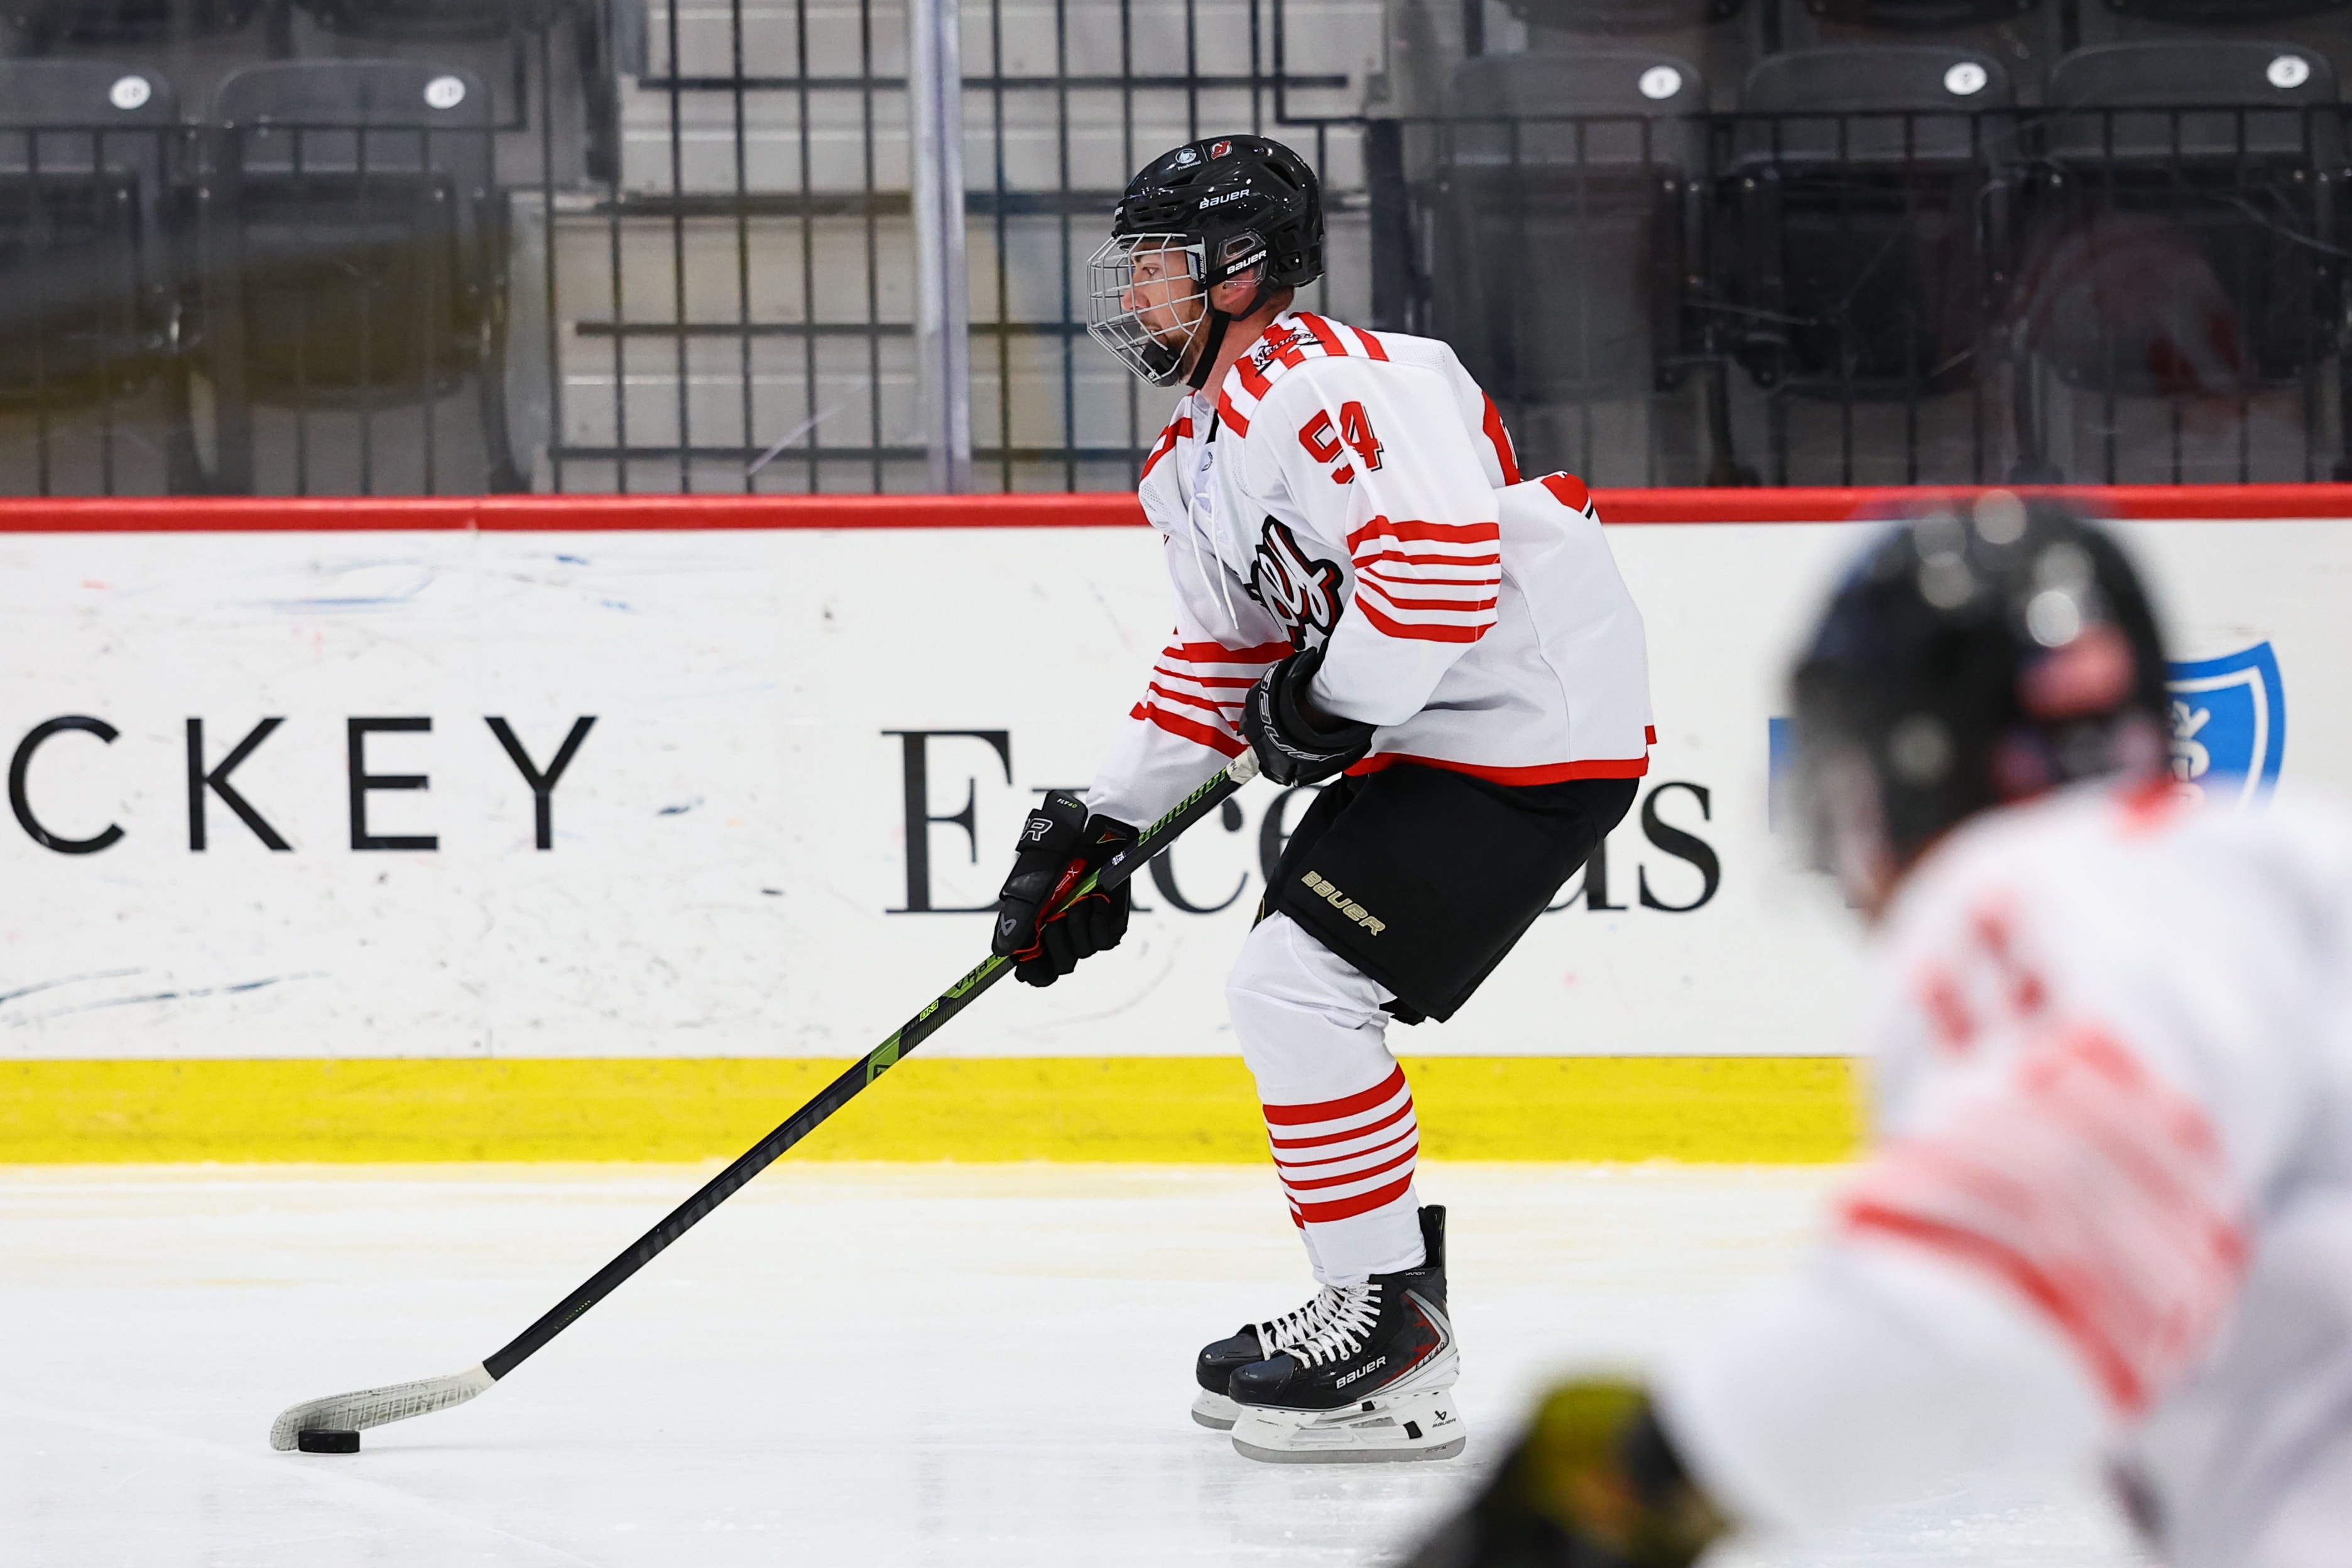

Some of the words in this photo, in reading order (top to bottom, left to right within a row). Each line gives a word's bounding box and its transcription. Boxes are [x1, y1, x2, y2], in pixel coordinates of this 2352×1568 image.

[1177, 160, 1202, 171] Prudential
[1199, 188, 1250, 210] BAUER
[1226, 249, 1267, 275] BAUER
[1253, 332, 1317, 368] Warriors
[1298, 401, 1385, 484] 94
[1258, 662, 1346, 762] BAUE
[8, 714, 599, 855] CKEY
[1300, 870, 1386, 937] BAUER
[1336, 1356, 1387, 1390] BAUER
[1432, 1417, 1456, 1429] BAUER
